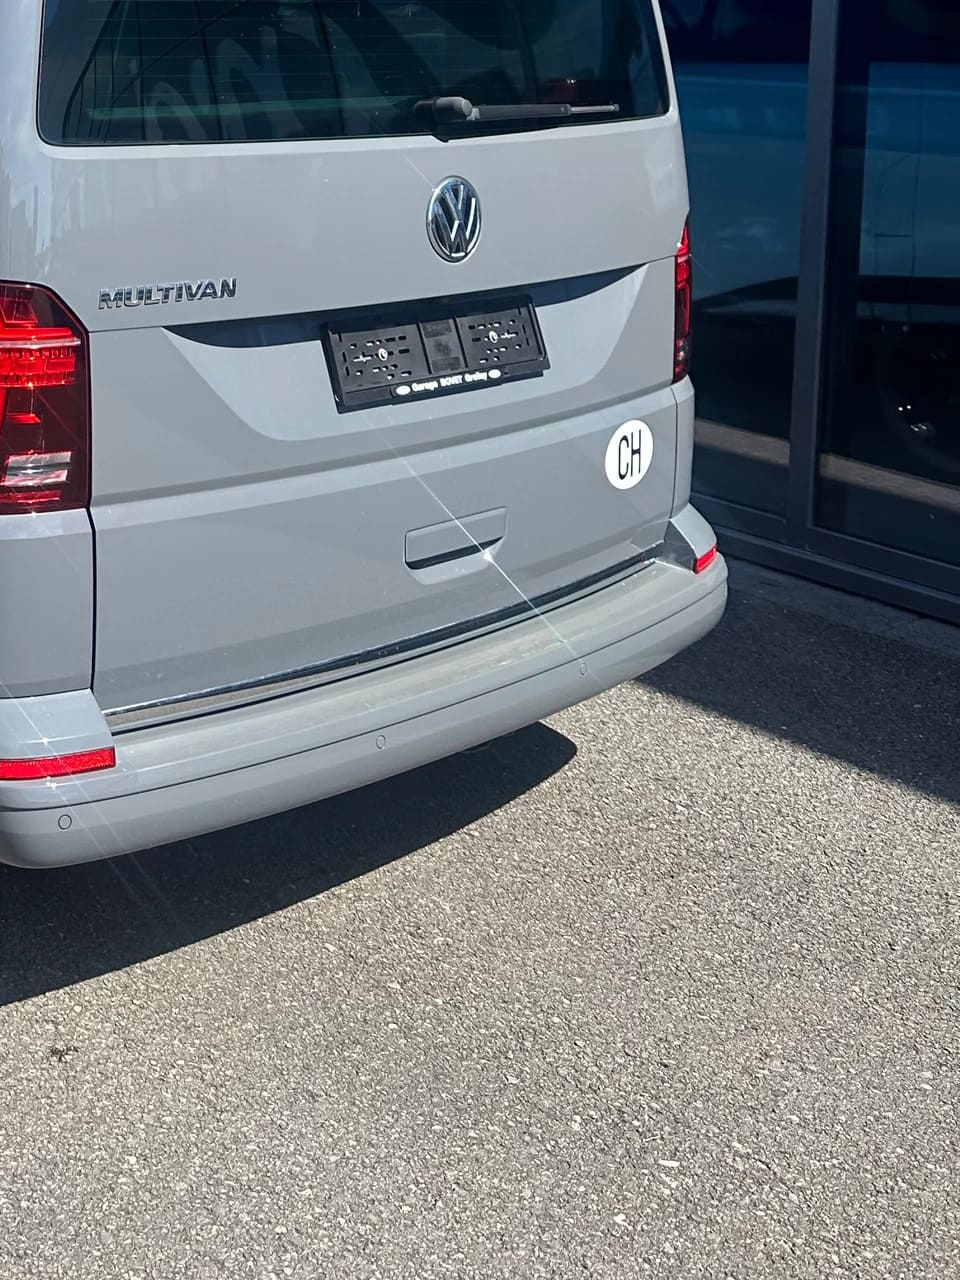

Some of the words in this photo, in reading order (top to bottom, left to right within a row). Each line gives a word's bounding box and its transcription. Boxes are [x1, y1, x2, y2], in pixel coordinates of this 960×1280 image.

[98, 277, 237, 310] MULTIVAN
[411, 381, 438, 393] Garage
[440, 375, 463, 387] BOVET
[618, 429, 641, 480] CH
